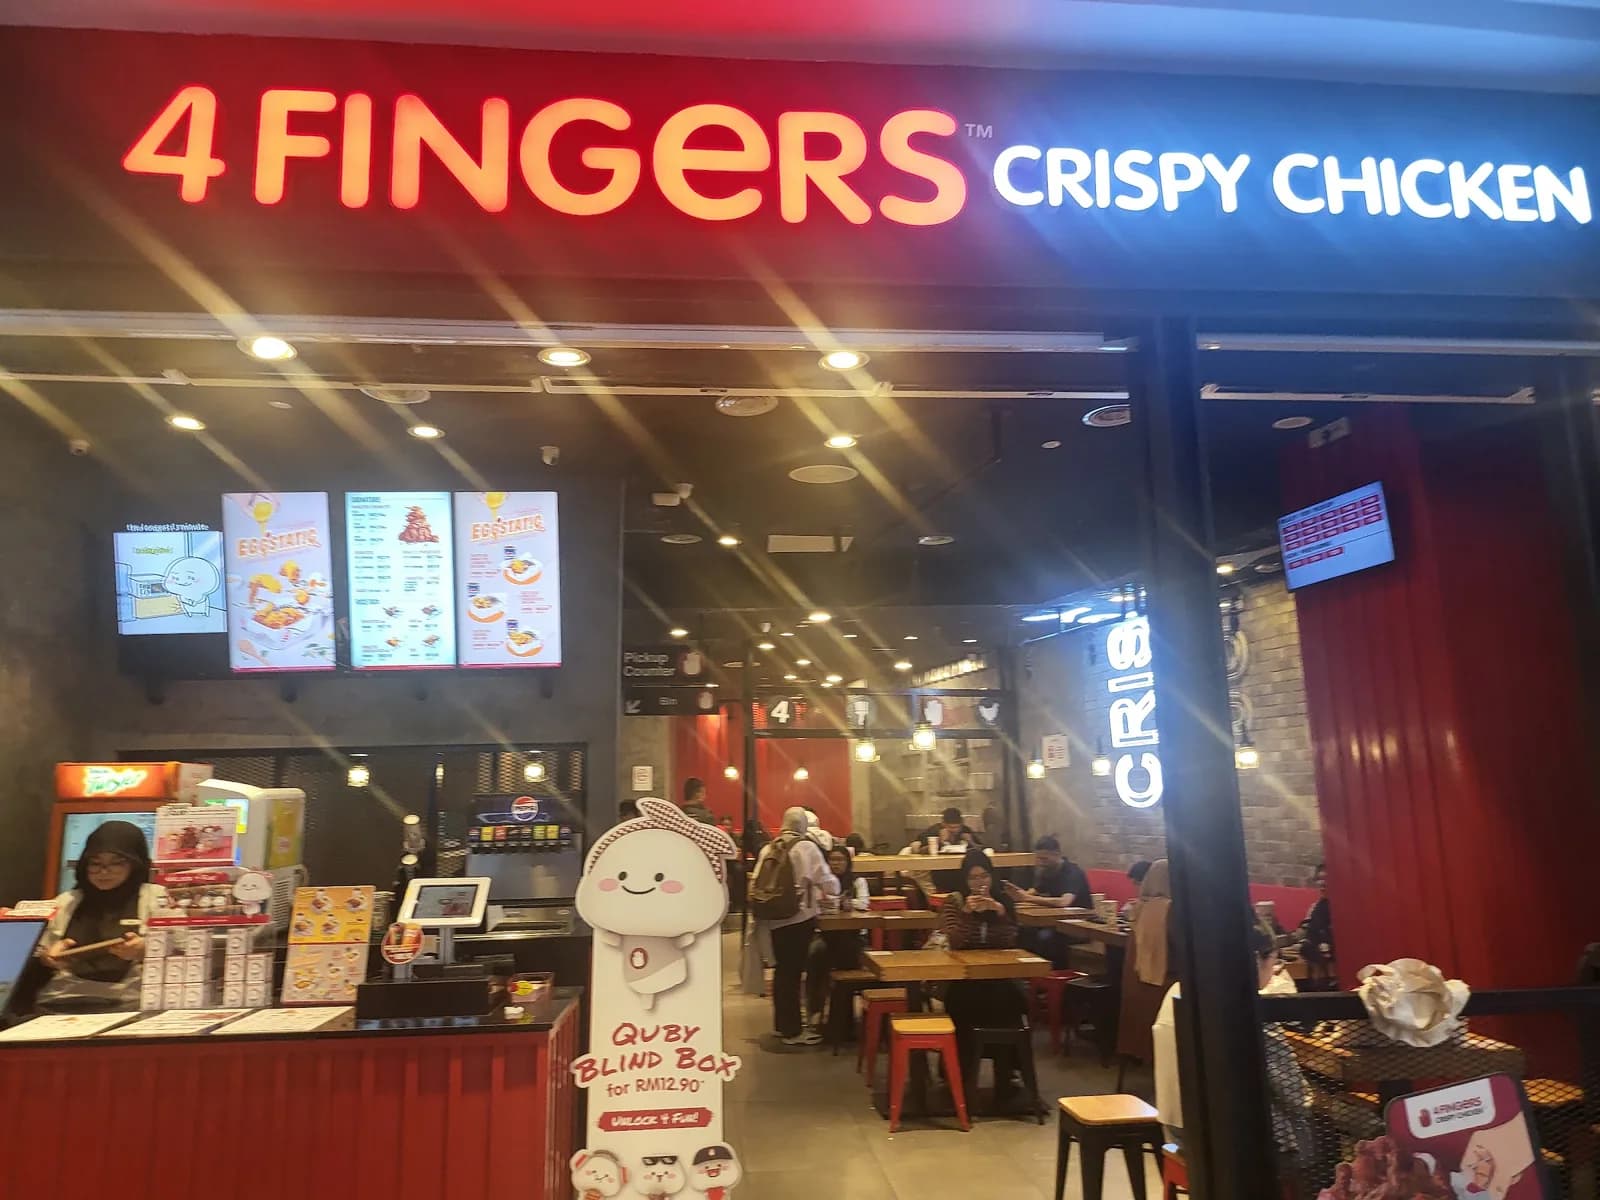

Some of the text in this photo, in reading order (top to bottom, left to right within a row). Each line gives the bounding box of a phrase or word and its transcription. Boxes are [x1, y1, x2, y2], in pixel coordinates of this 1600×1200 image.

[123, 86, 226, 203] 4
[993, 145, 1593, 225] CRISPY CHICKEN
[623, 652, 669, 665] Pickup
[623, 665, 677, 677] Counter
[770, 700, 790, 723] 4
[612, 1022, 701, 1046] QUBY
[575, 1047, 737, 1083] BLIND BOX
[606, 1083, 631, 1097] for
